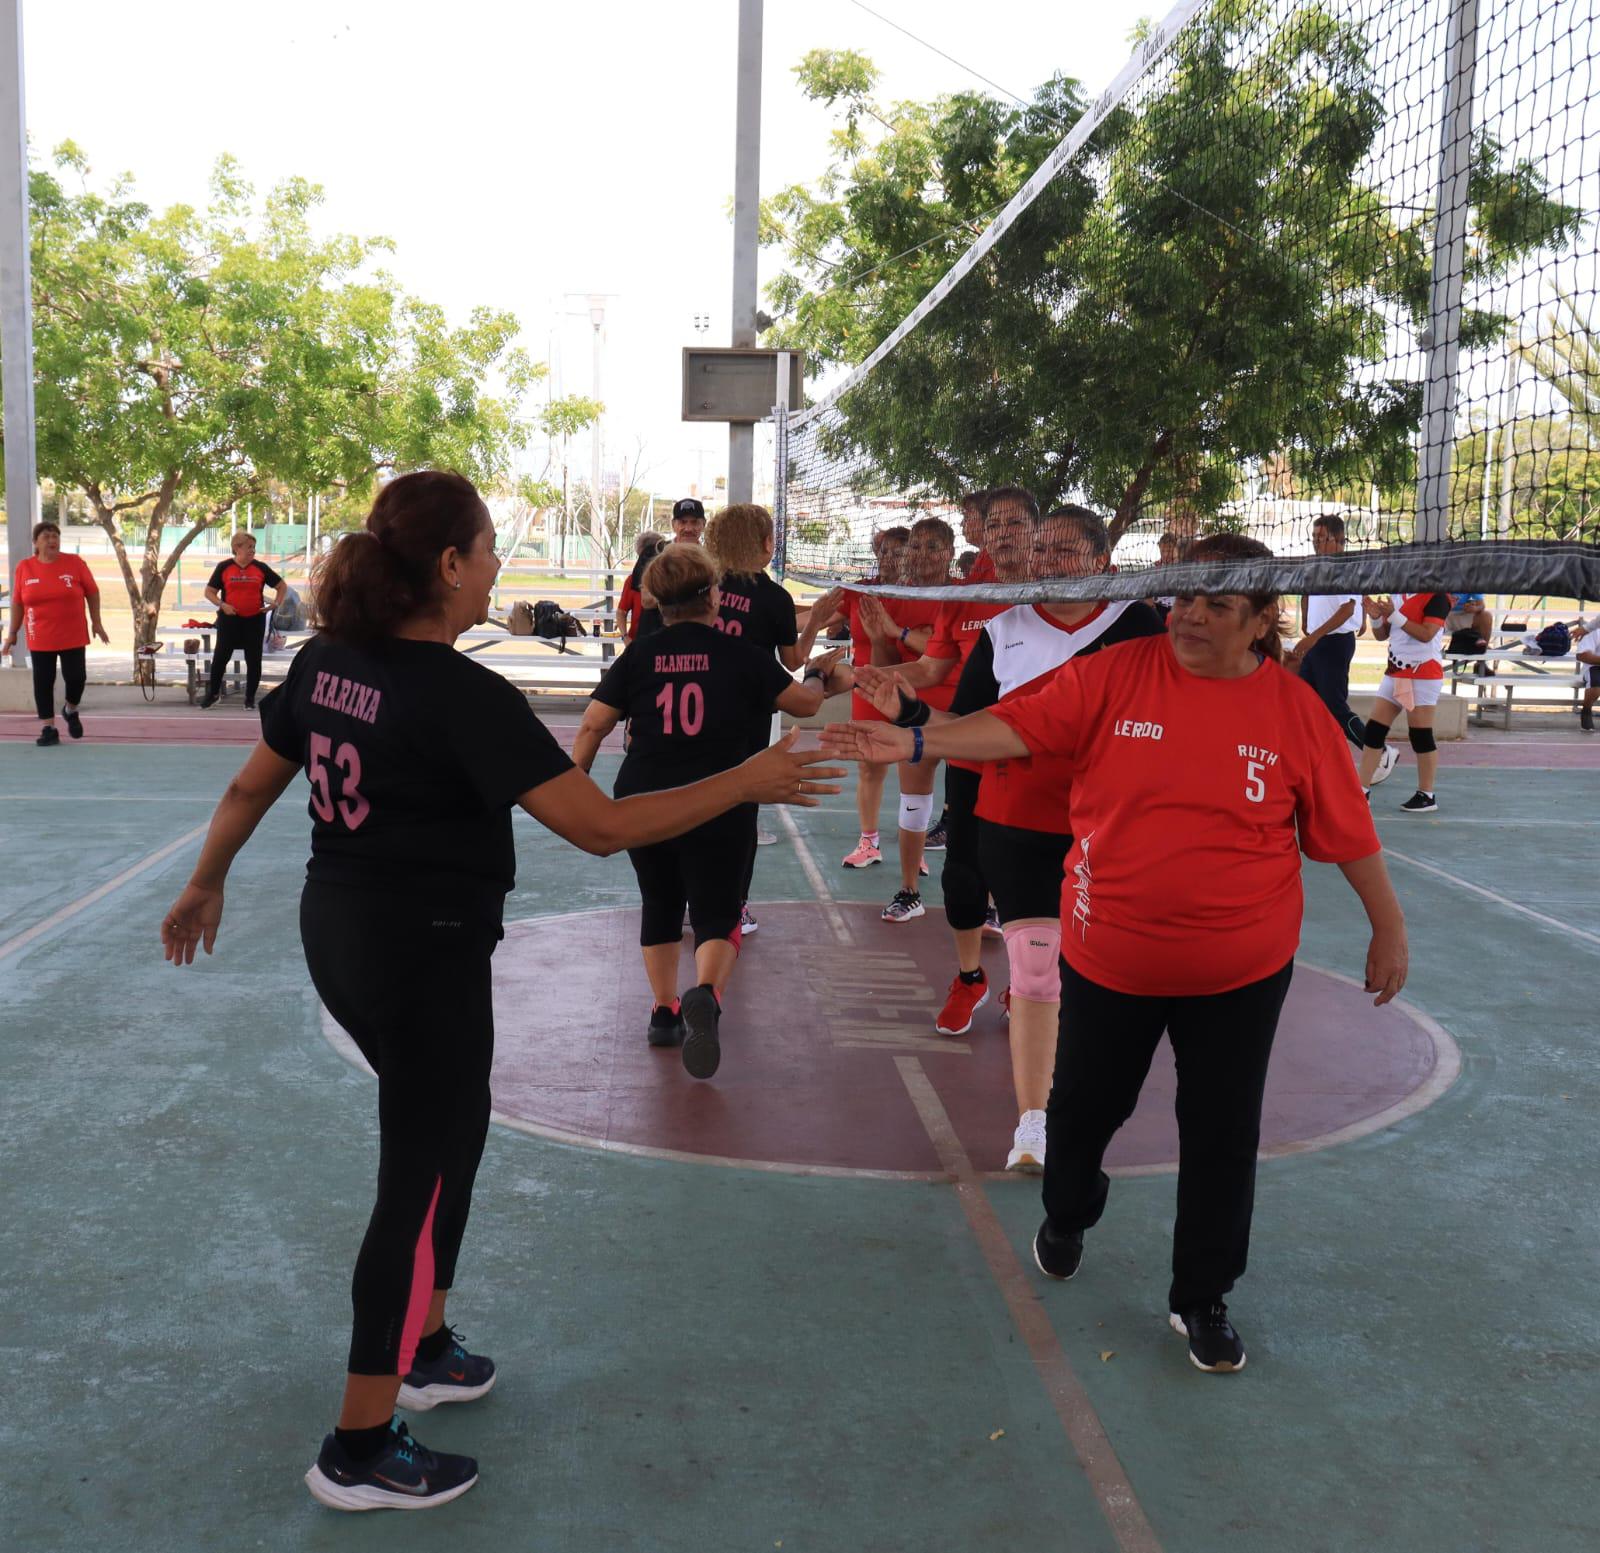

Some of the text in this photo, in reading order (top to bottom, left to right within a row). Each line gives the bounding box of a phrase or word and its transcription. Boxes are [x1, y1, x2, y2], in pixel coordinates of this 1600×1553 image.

[719, 590, 751, 613] LIVIA
[654, 653, 710, 673] BLANKITA
[311, 671, 382, 725] KARINA
[655, 682, 705, 737] 10
[1237, 744, 1279, 767] RUTH
[308, 731, 370, 831] 53
[1245, 760, 1266, 803] 5
